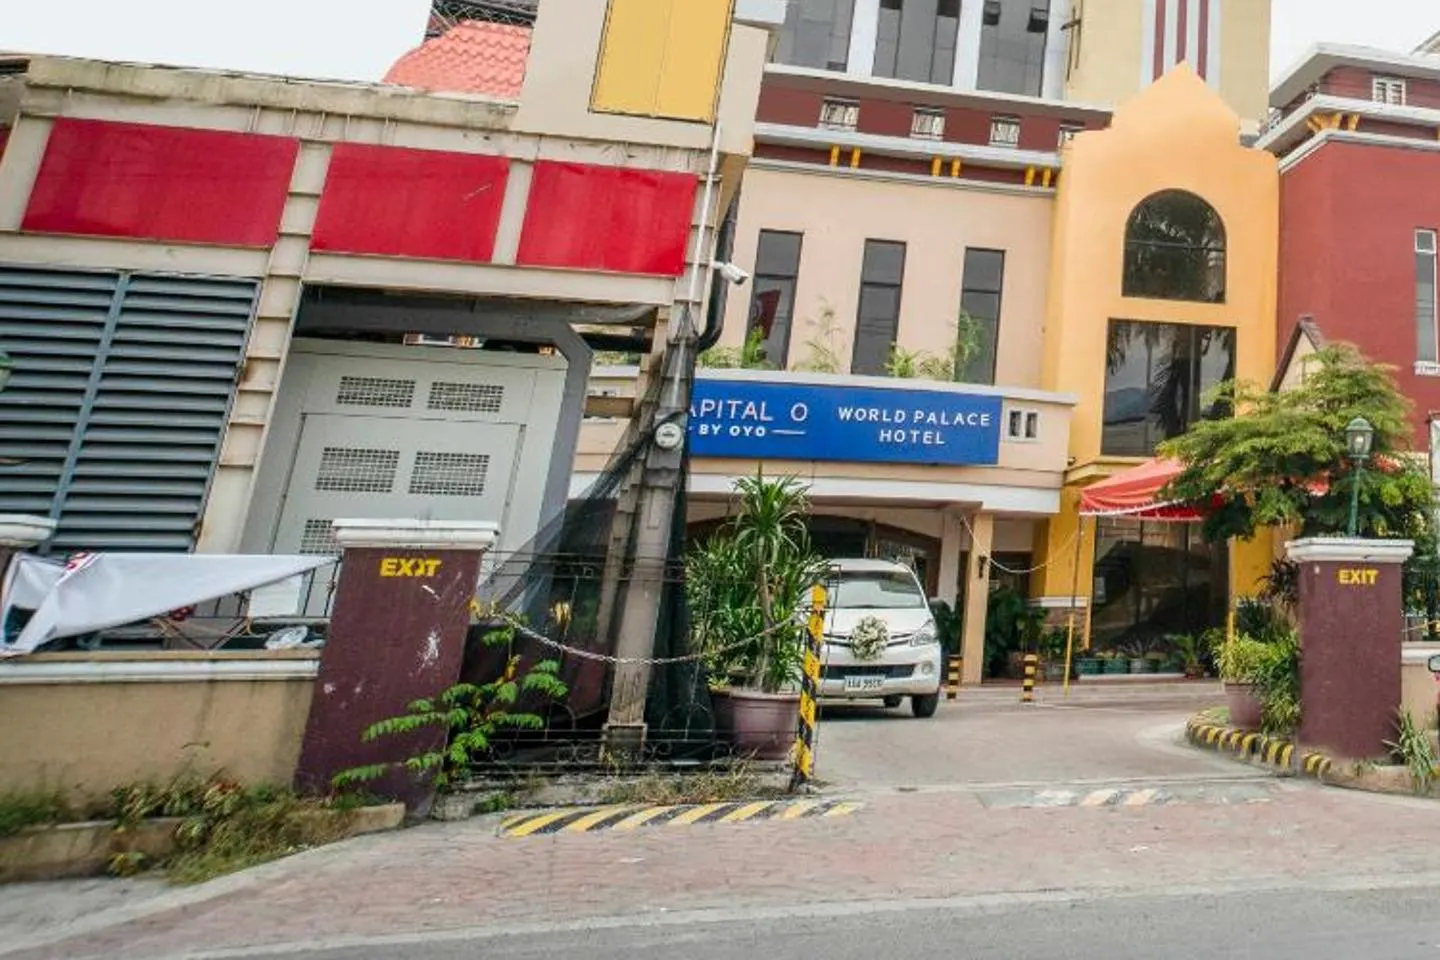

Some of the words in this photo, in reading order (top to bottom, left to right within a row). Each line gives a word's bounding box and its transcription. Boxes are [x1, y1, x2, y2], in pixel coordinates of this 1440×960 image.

[790, 402, 808, 421] O
[838, 406, 906, 423] WORLD
[913, 410, 991, 427] PALACE
[699, 423, 722, 435] BY
[729, 425, 766, 437] OYO
[879, 429, 946, 445] HOTEL
[380, 557, 442, 577] EXIT
[1339, 568, 1379, 584] EXIT
